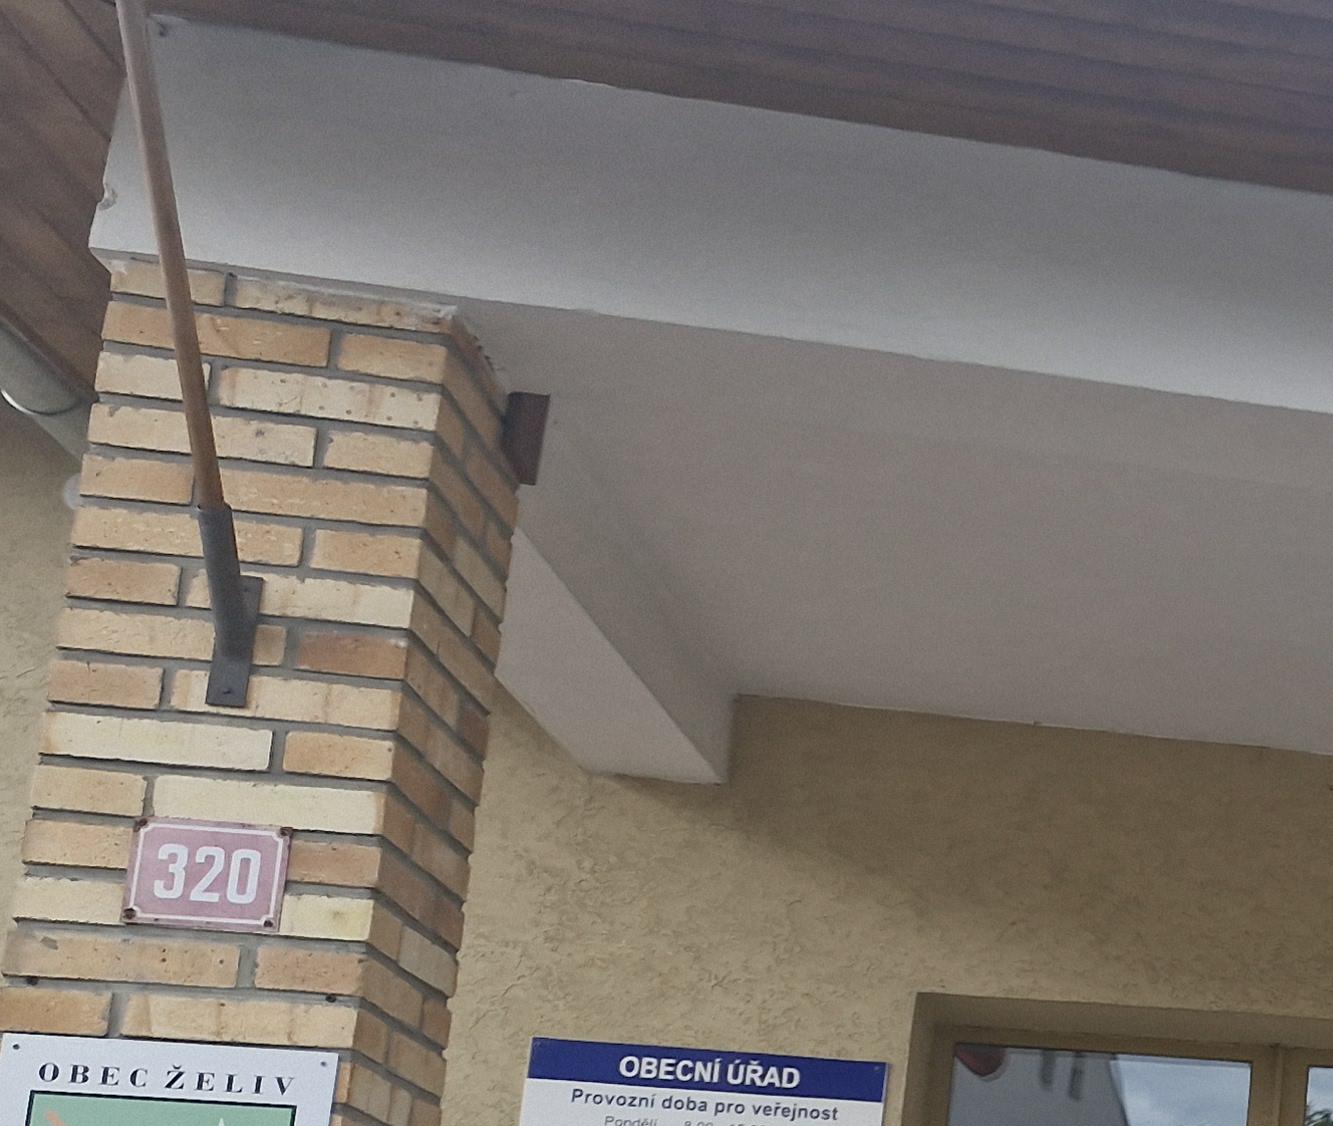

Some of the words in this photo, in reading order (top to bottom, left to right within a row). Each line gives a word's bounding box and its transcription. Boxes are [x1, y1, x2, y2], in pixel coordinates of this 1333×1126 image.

[152, 842, 263, 905] 320
[38, 1062, 148, 1088] OBEC
[163, 1064, 296, 1096] ŽELIV
[619, 1055, 719, 1084] OBECNÍ
[726, 1059, 800, 1088] ÚŘAD
[571, 1088, 655, 1108] Provozní
[661, 1095, 707, 1112] doba
[714, 1101, 745, 1117] pro
[752, 1104, 839, 1121] veřejnost
